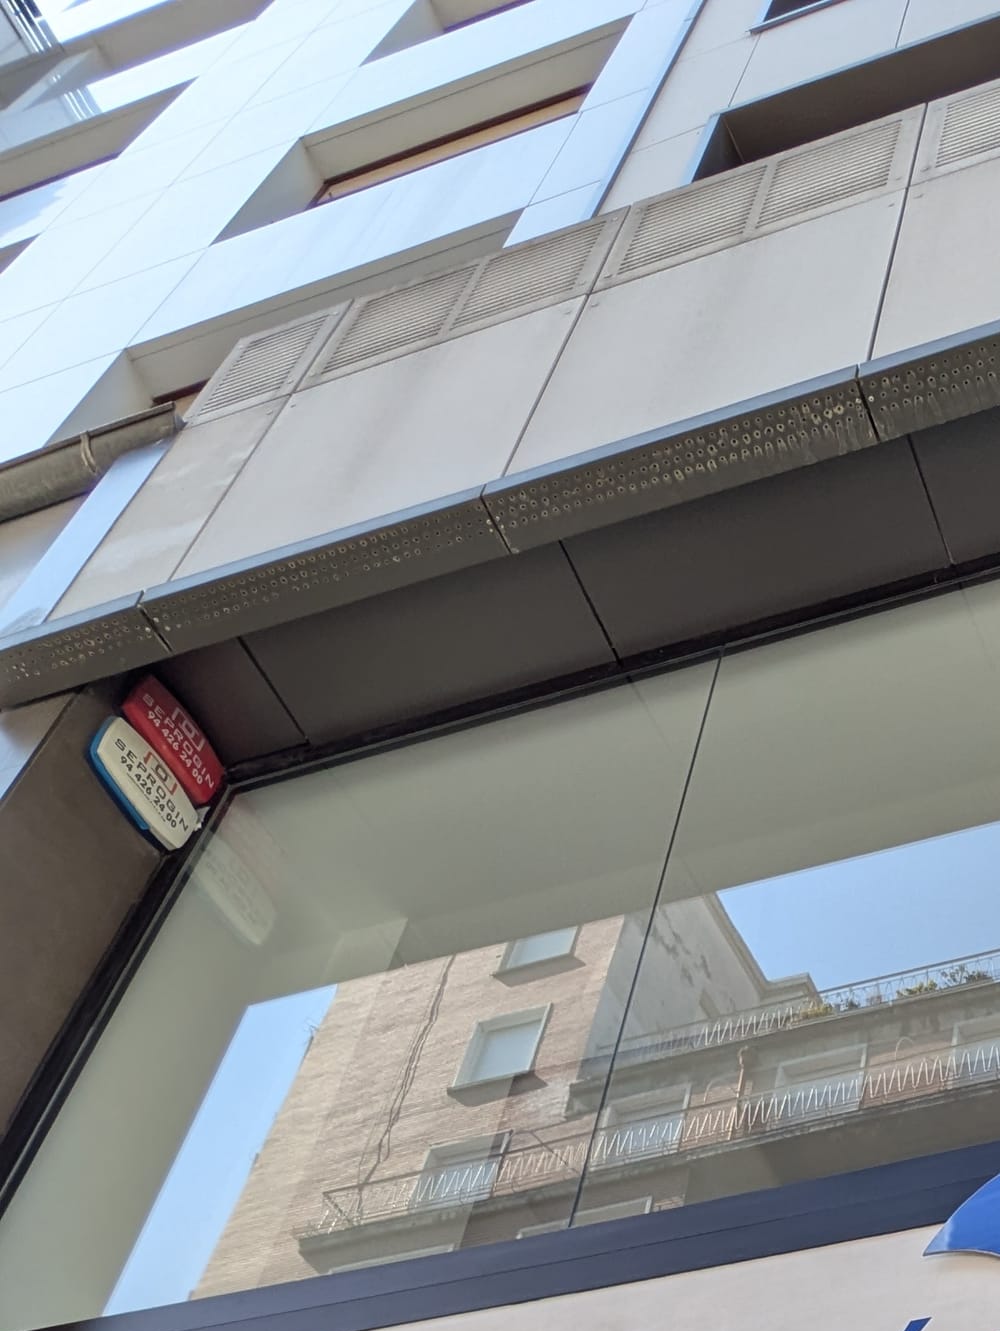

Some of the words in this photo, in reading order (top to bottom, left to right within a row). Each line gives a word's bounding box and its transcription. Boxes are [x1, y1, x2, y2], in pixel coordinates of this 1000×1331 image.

[143, 693, 214, 788] SEPROGIN
[148, 710, 161, 727] 94
[161, 728, 180, 751] 426
[179, 751, 193, 768] 24
[192, 768, 203, 785] 00
[115, 738, 188, 832] SEPROGIN
[120, 756, 133, 772] 94
[134, 773, 153, 795] 426
[153, 796, 166, 812] 24
[166, 813, 177, 828] 00
